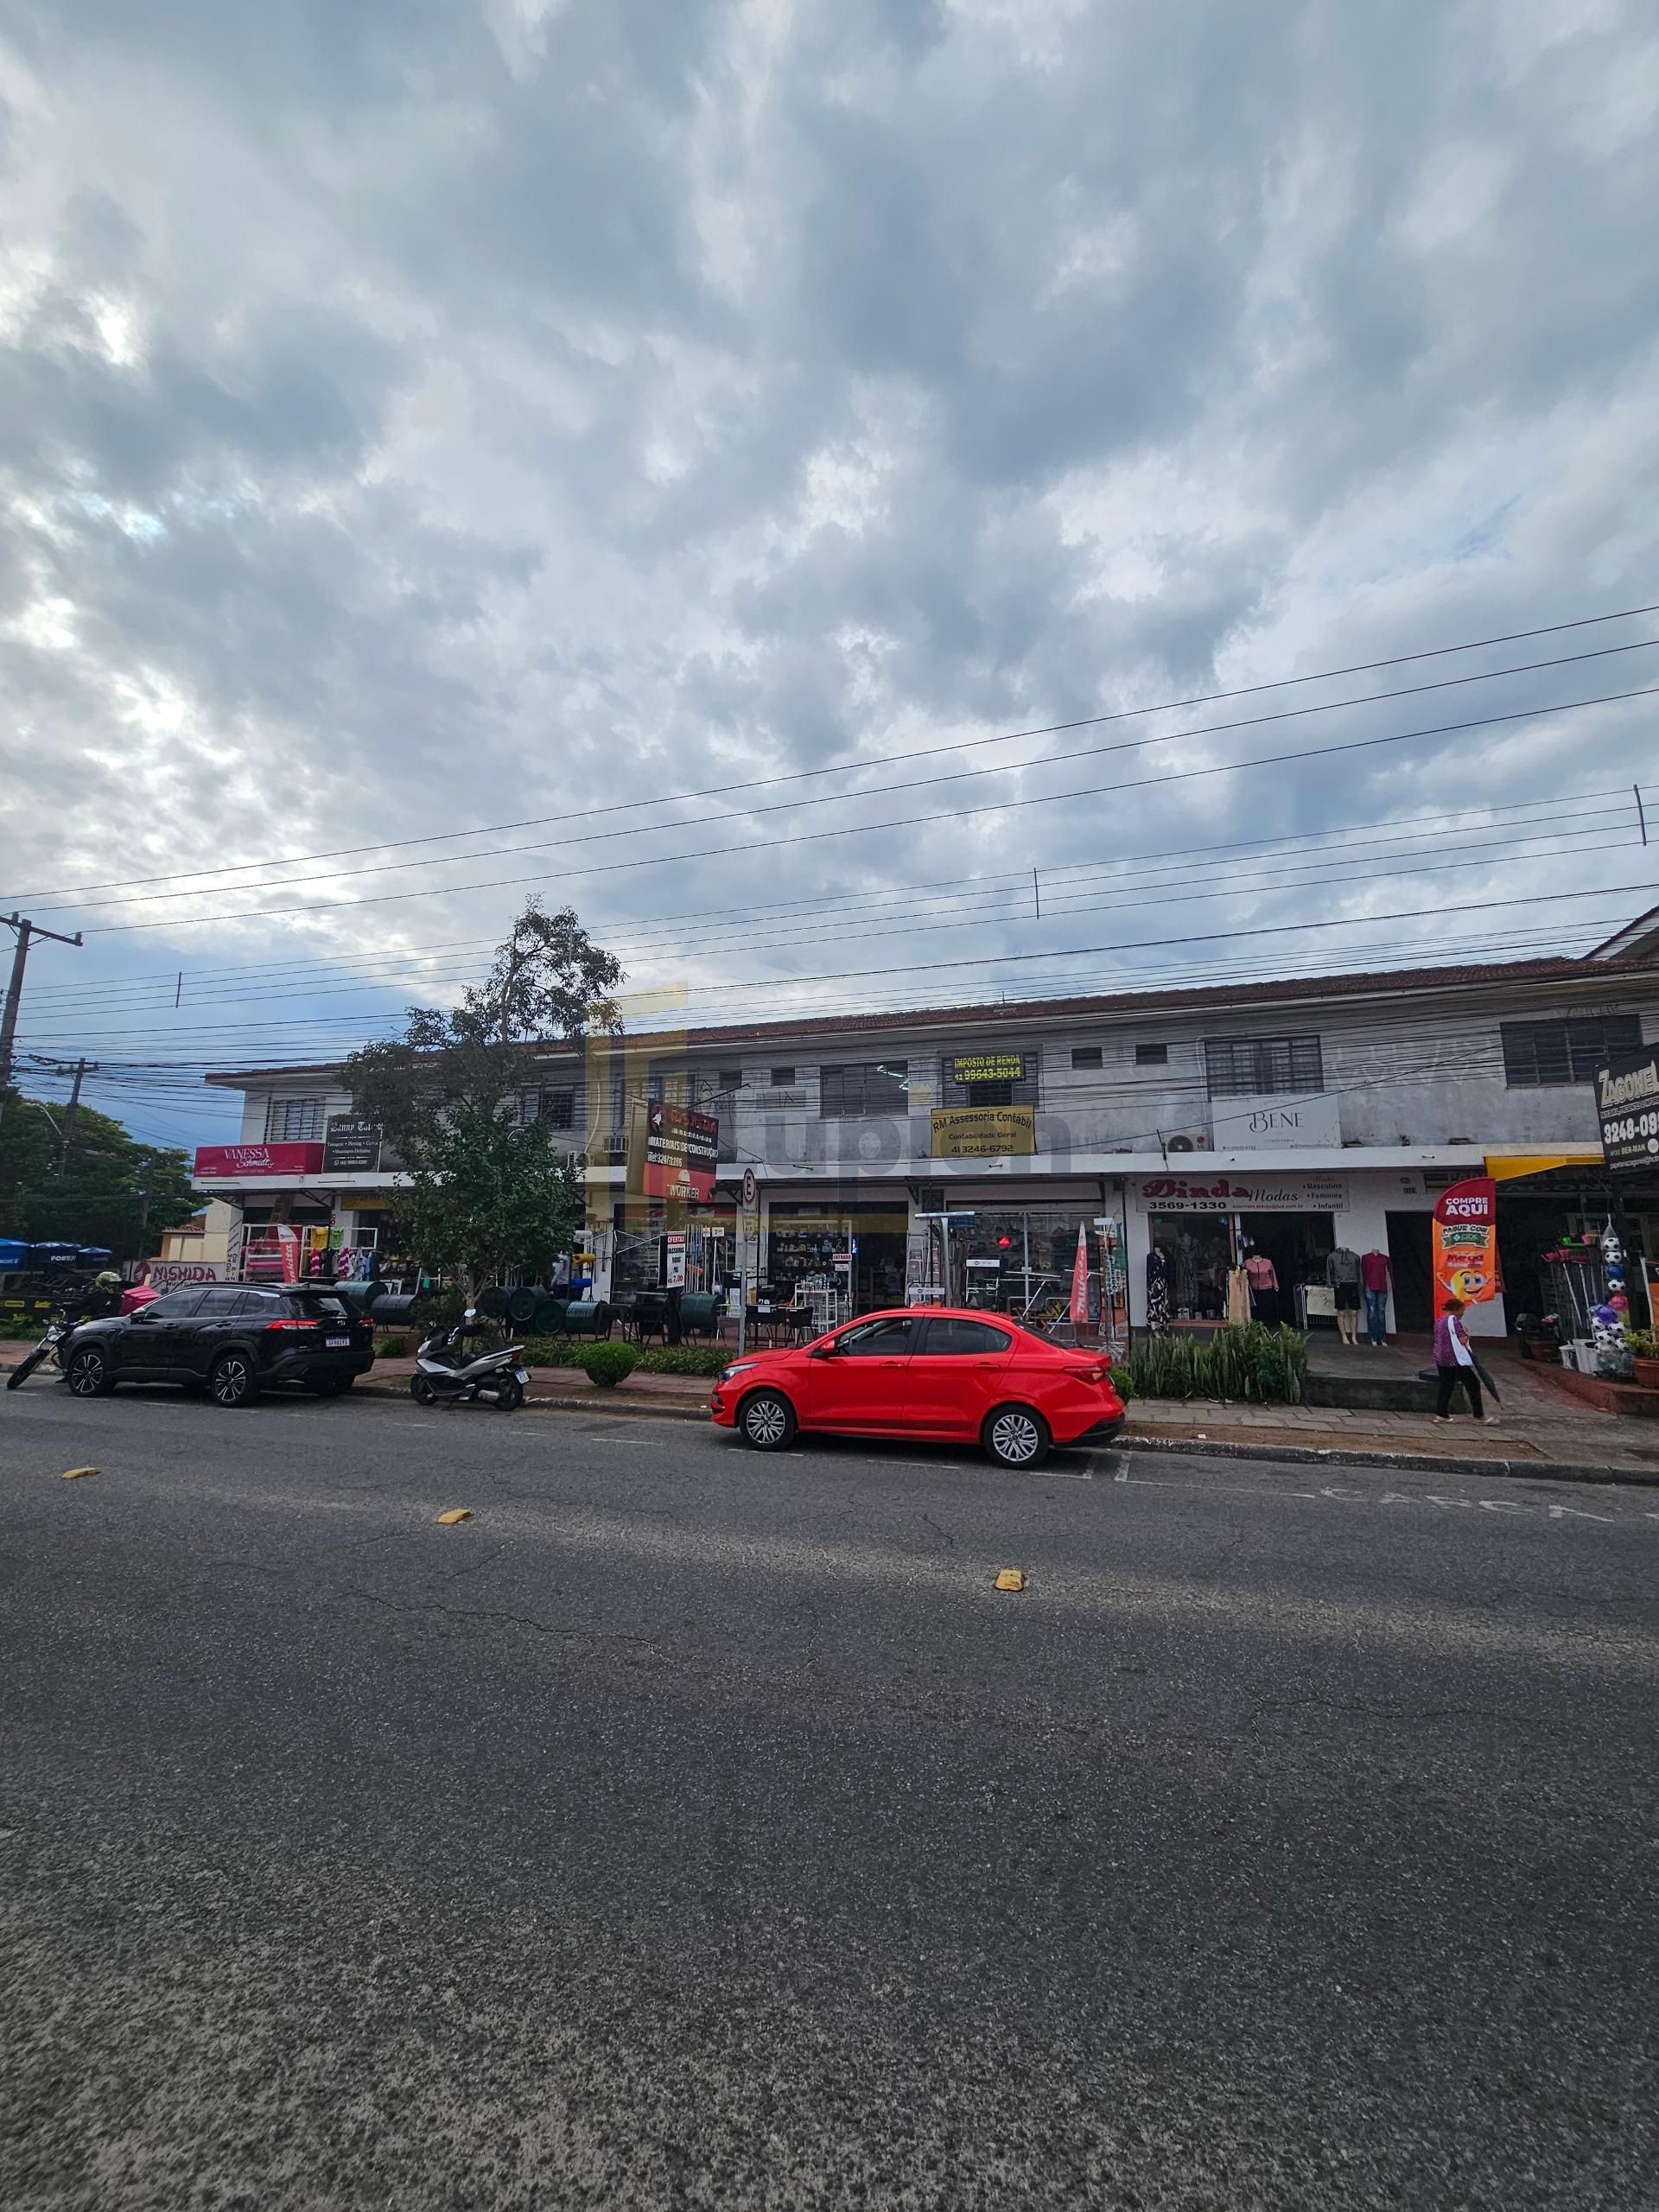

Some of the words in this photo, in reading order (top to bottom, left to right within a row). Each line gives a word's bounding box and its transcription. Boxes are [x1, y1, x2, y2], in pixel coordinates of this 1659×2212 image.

[955, 1058, 984, 1068] IMPOSTO
[986, 1057, 995, 1065] DE
[996, 1054, 1020, 1065] RENDA
[933, 1118, 947, 1133] RM
[949, 1111, 995, 1125] Assessoria
[1249, 1112, 1305, 1133] BENE
[224, 1147, 270, 1160] VANESSA
[670, 1185, 700, 1198] WORKER
[747, 1176, 751, 1195] E
[1142, 1179, 1250, 1198] Dinda
[1249, 1189, 1299, 1202] Modas
[1446, 1205, 1488, 1217] AQUI
[1443, 1225, 1468, 1235] PAGUE
[154, 1266, 216, 1281] NISHIDA
